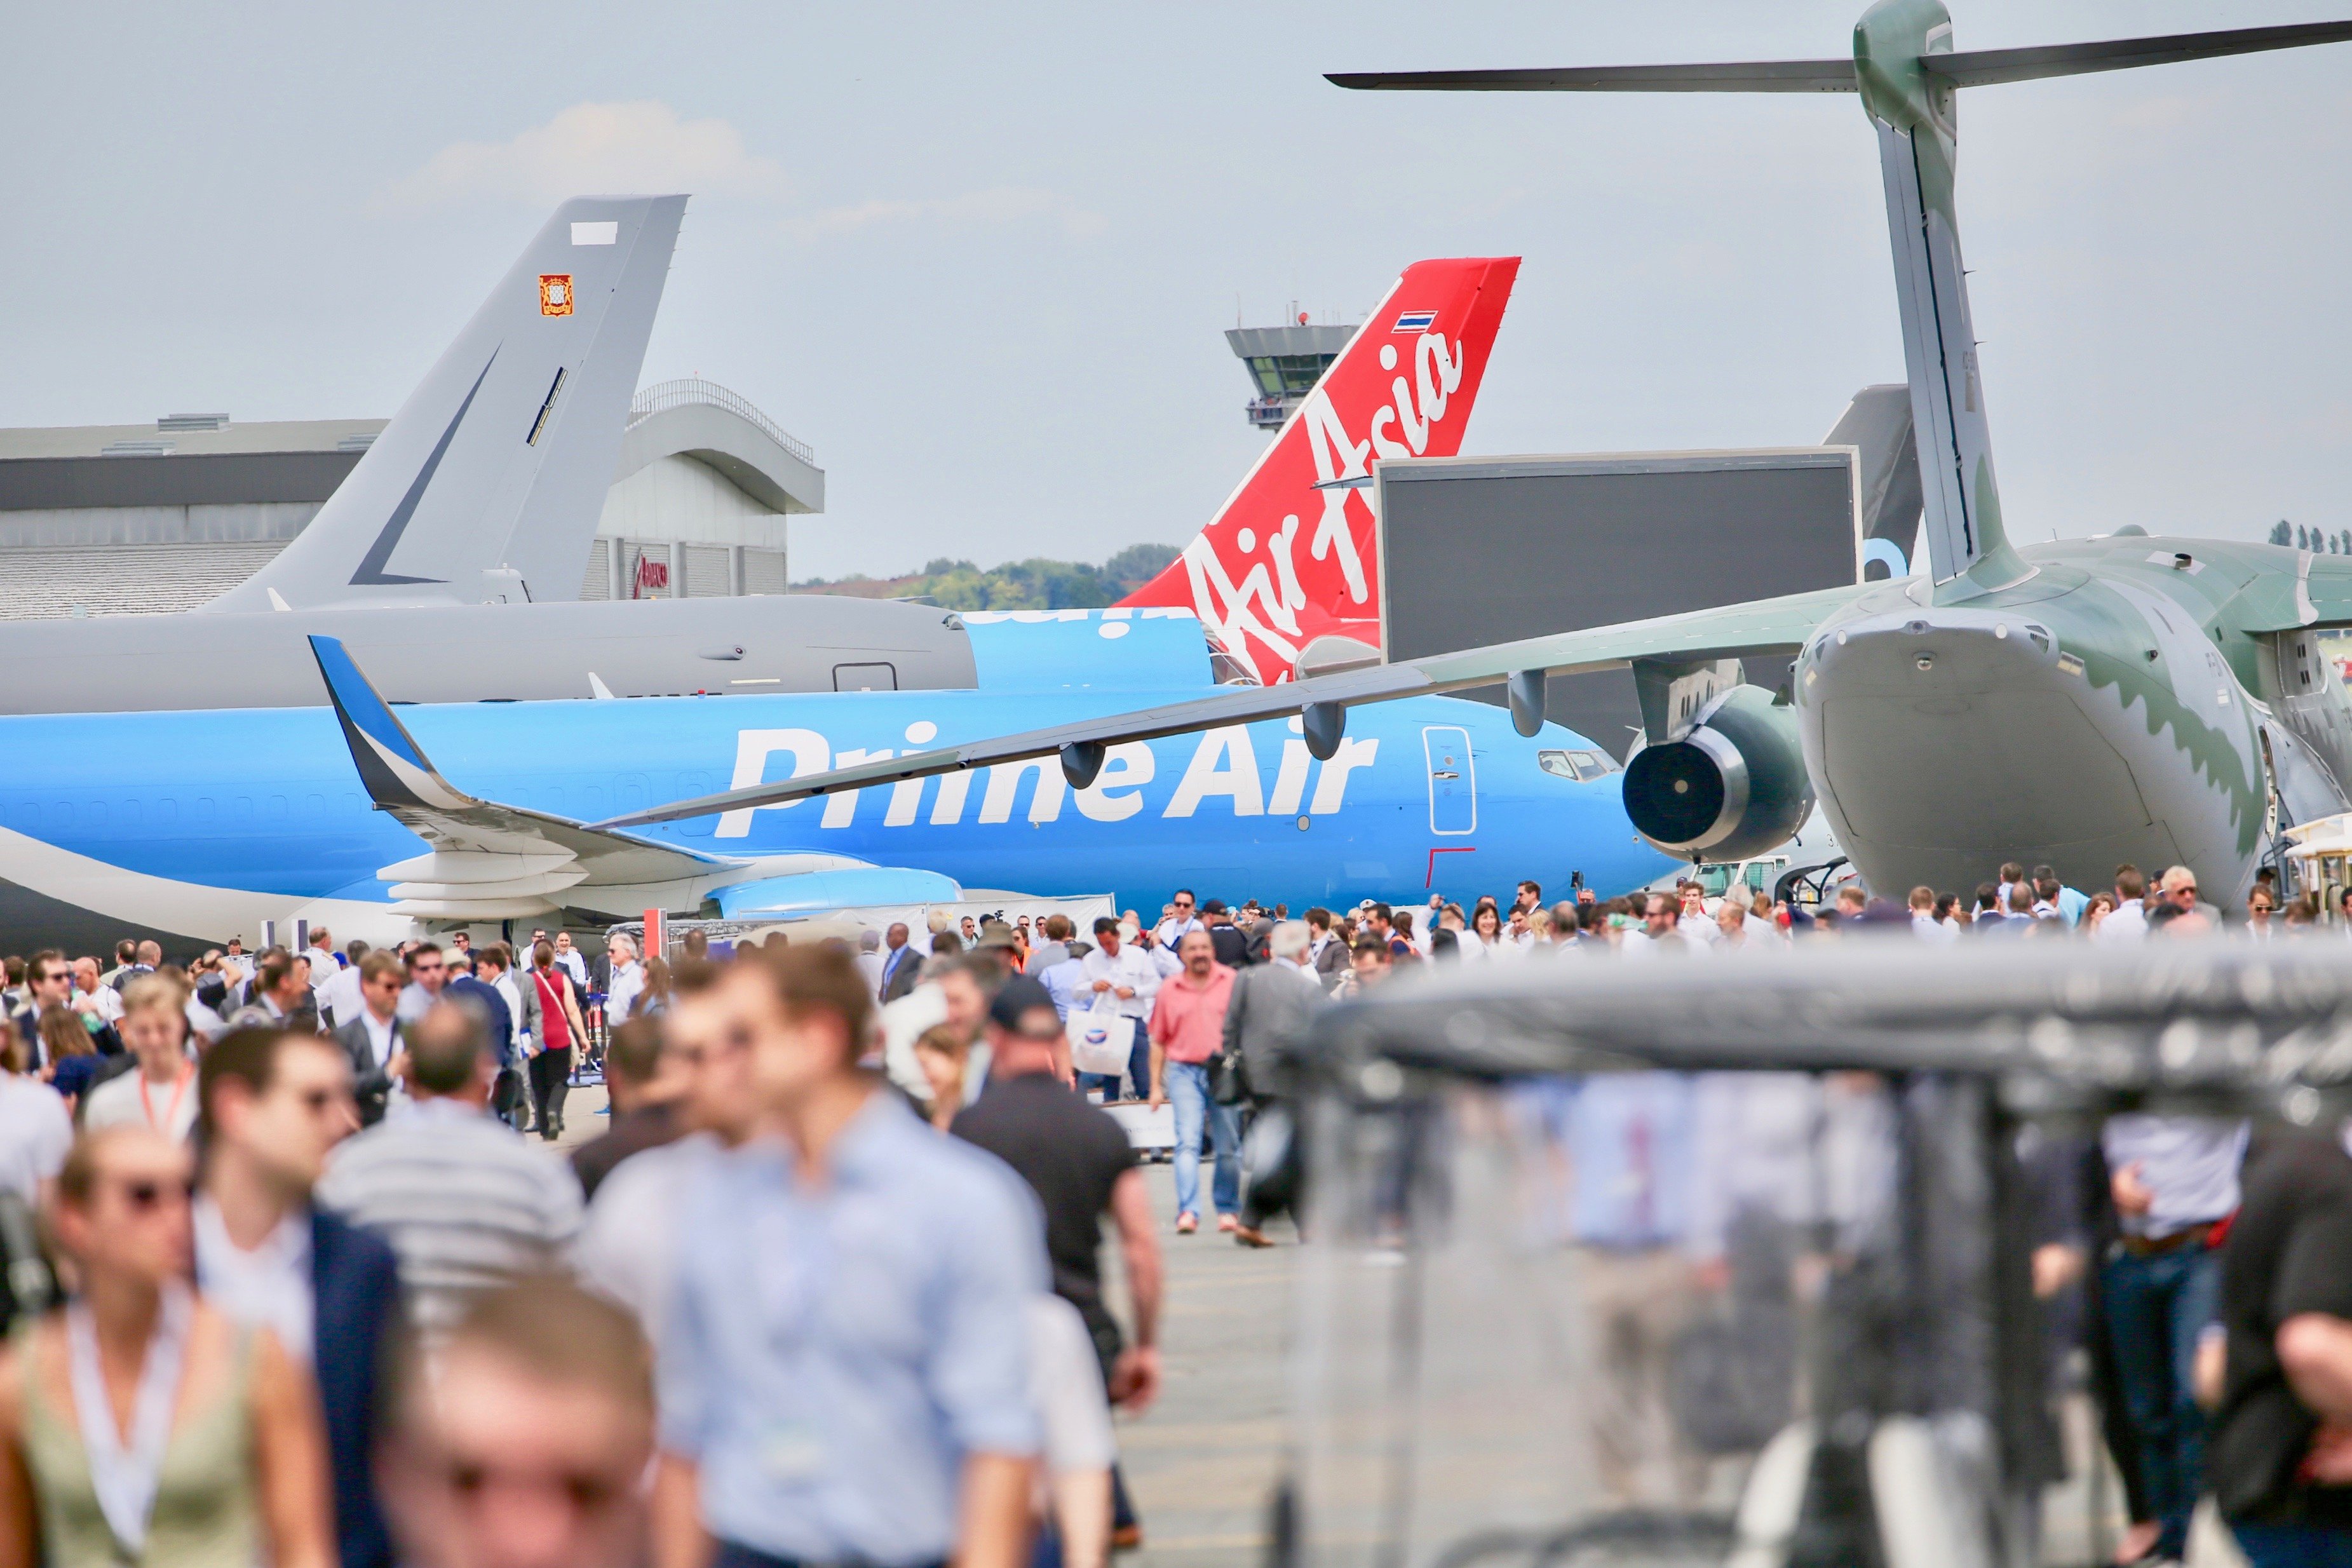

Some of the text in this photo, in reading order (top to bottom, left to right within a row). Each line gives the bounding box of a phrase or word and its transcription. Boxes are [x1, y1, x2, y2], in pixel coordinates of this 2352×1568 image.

[1182, 514, 1306, 686] Air
[715, 714, 1379, 838] Prime Air
